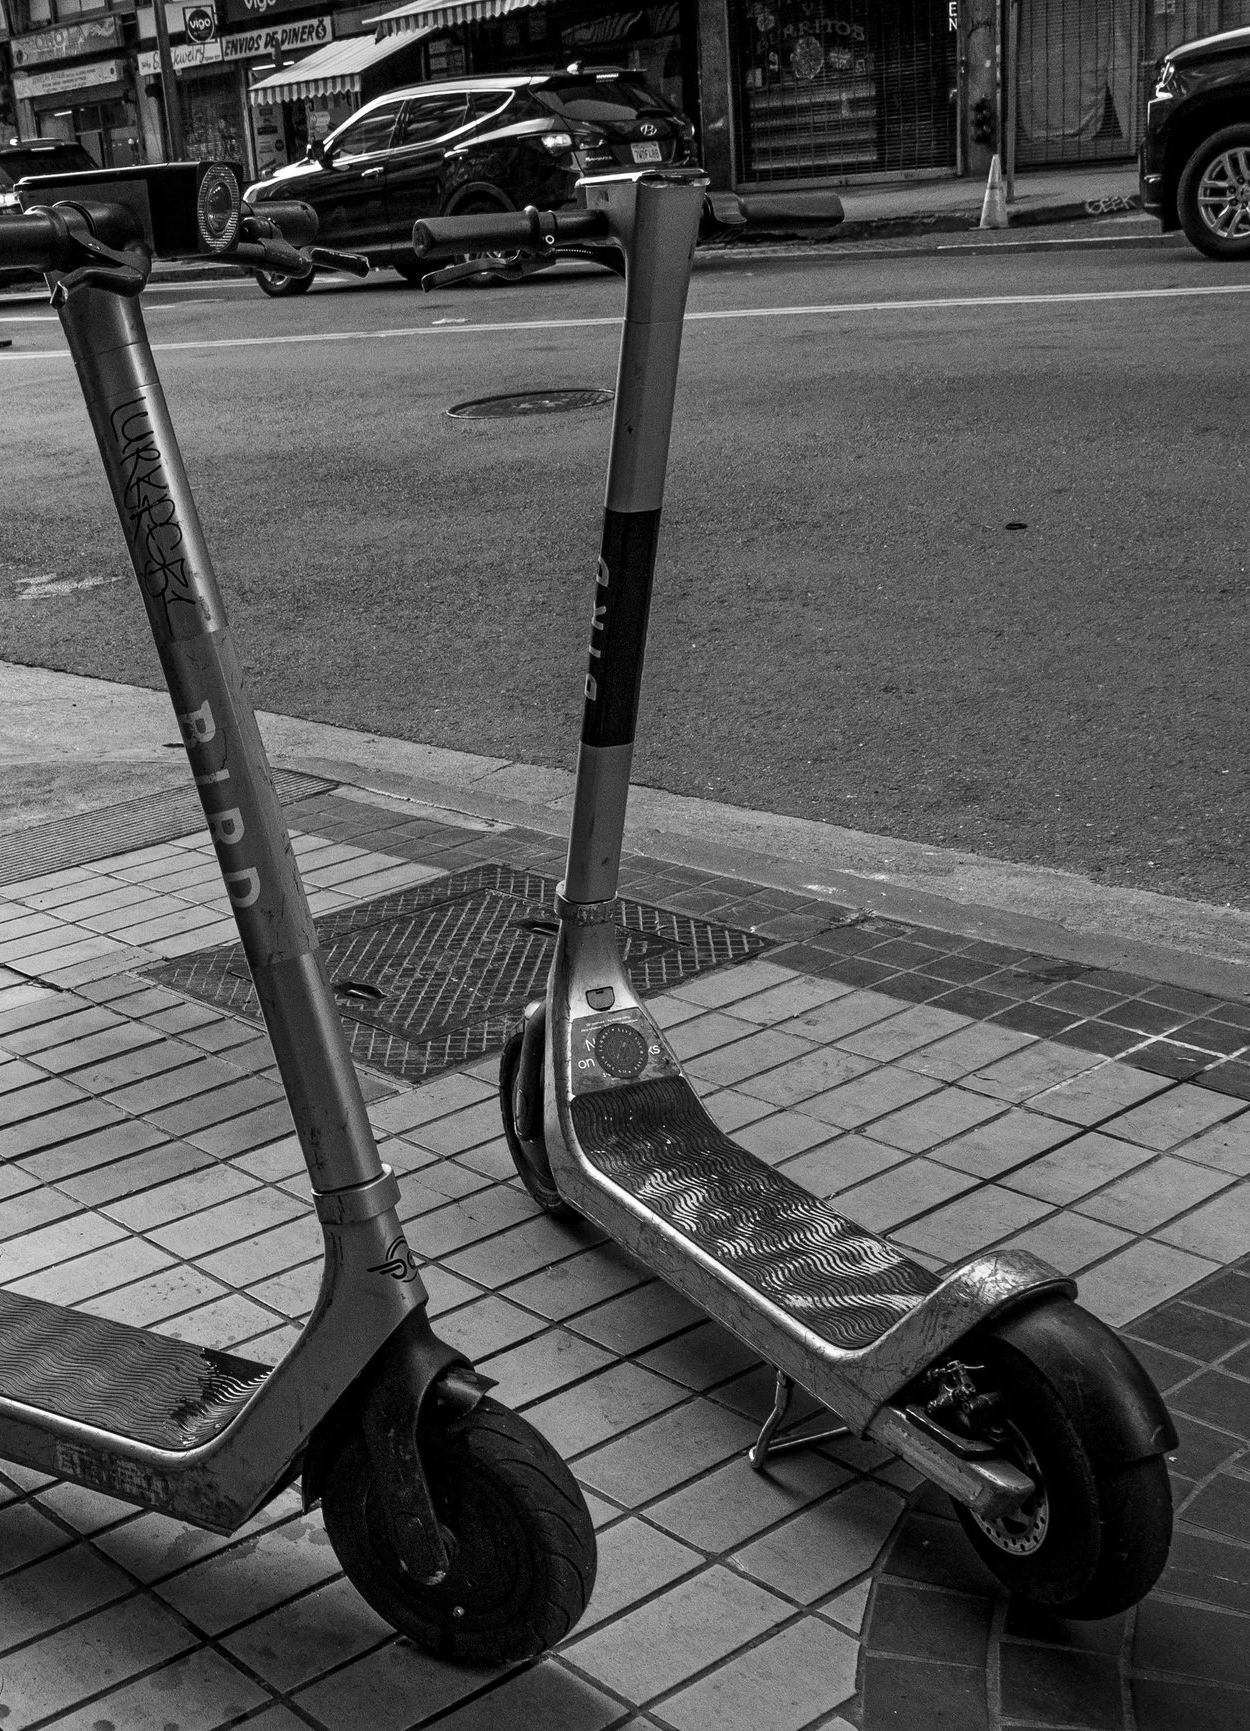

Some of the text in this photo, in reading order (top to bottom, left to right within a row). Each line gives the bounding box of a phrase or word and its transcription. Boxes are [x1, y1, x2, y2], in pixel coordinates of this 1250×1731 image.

[189, 17, 211, 30] vigo
[224, 34, 262, 57] ENVIOS
[263, 31, 279, 49] DE
[179, 699, 261, 909] BIRD
